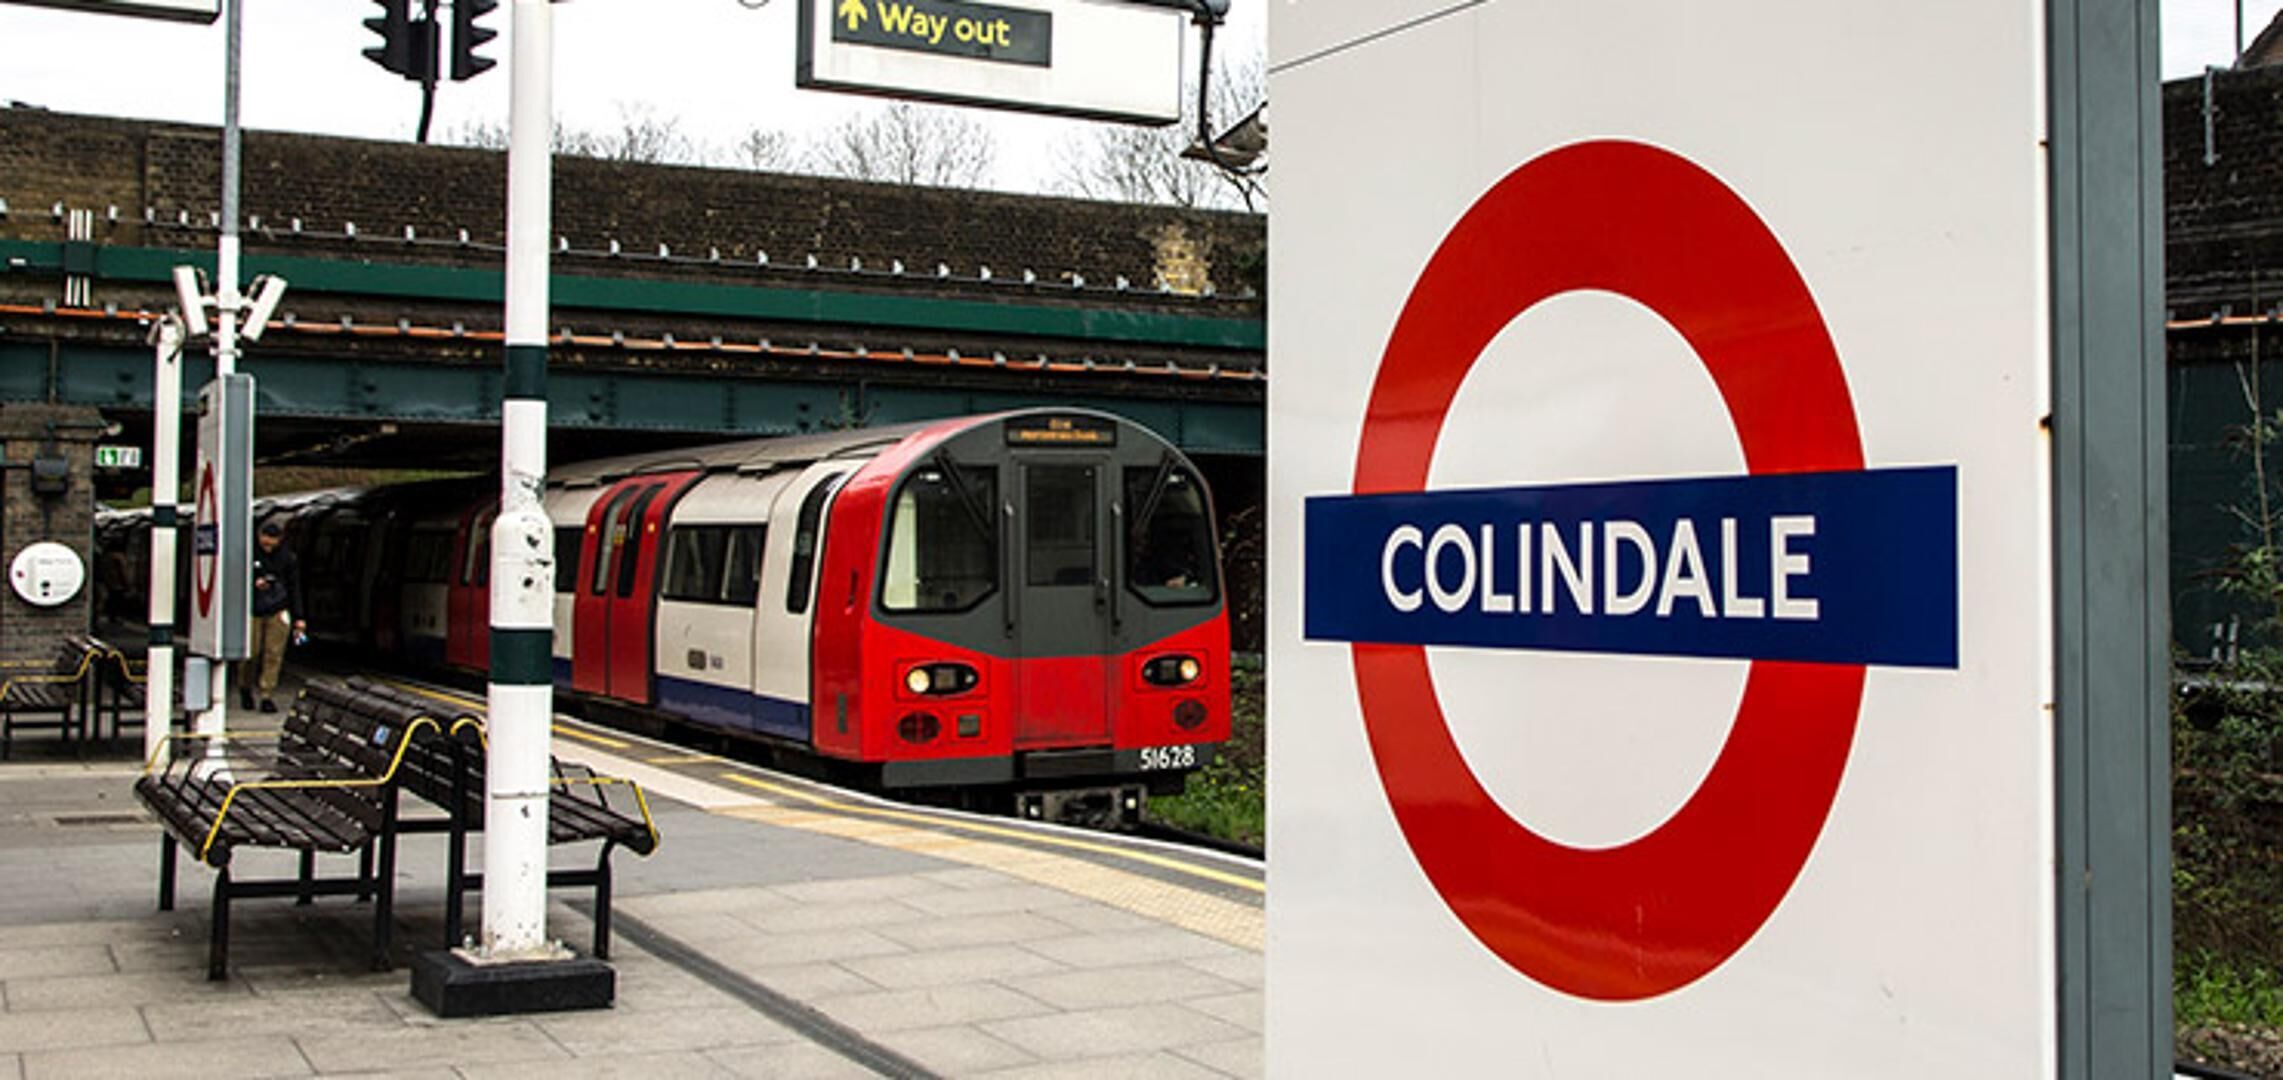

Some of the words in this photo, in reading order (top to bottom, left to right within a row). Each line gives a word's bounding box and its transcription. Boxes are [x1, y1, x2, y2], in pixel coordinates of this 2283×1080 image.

[876, 0, 948, 45] Way
[953, 18, 1010, 47] out
[1381, 515, 1819, 620] COLINDALE
[1140, 744, 1196, 771] 51628
